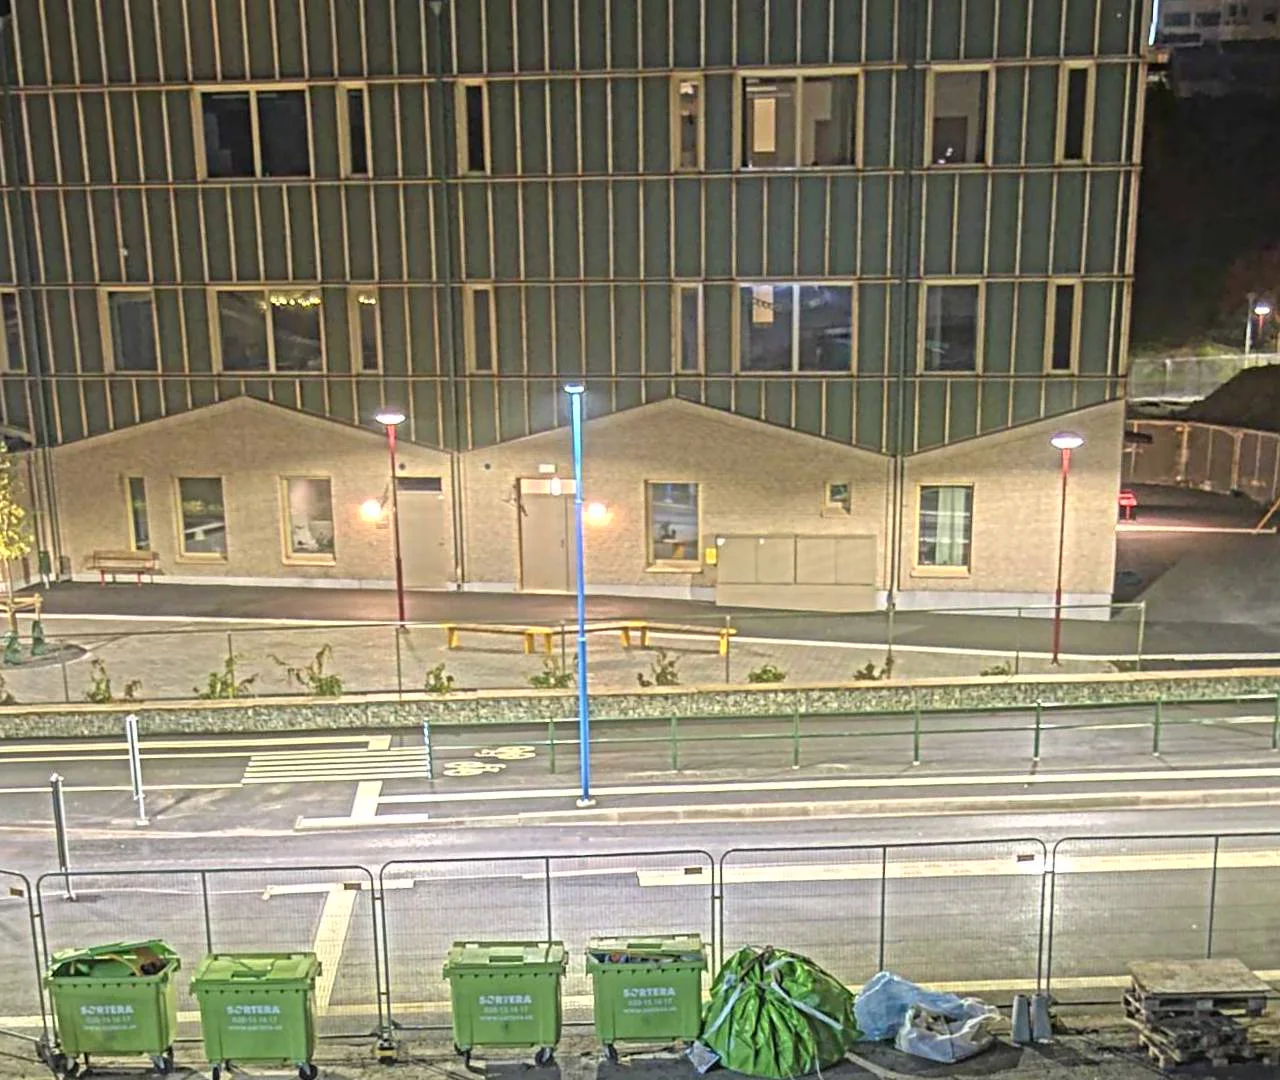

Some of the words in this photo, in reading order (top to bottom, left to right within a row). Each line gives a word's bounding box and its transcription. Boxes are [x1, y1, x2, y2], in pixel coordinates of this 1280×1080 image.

[623, 987, 676, 998] SORTERA
[479, 995, 532, 1005] SORTERA
[80, 1004, 134, 1015] SORTERA
[226, 1005, 280, 1015] SORTERA
